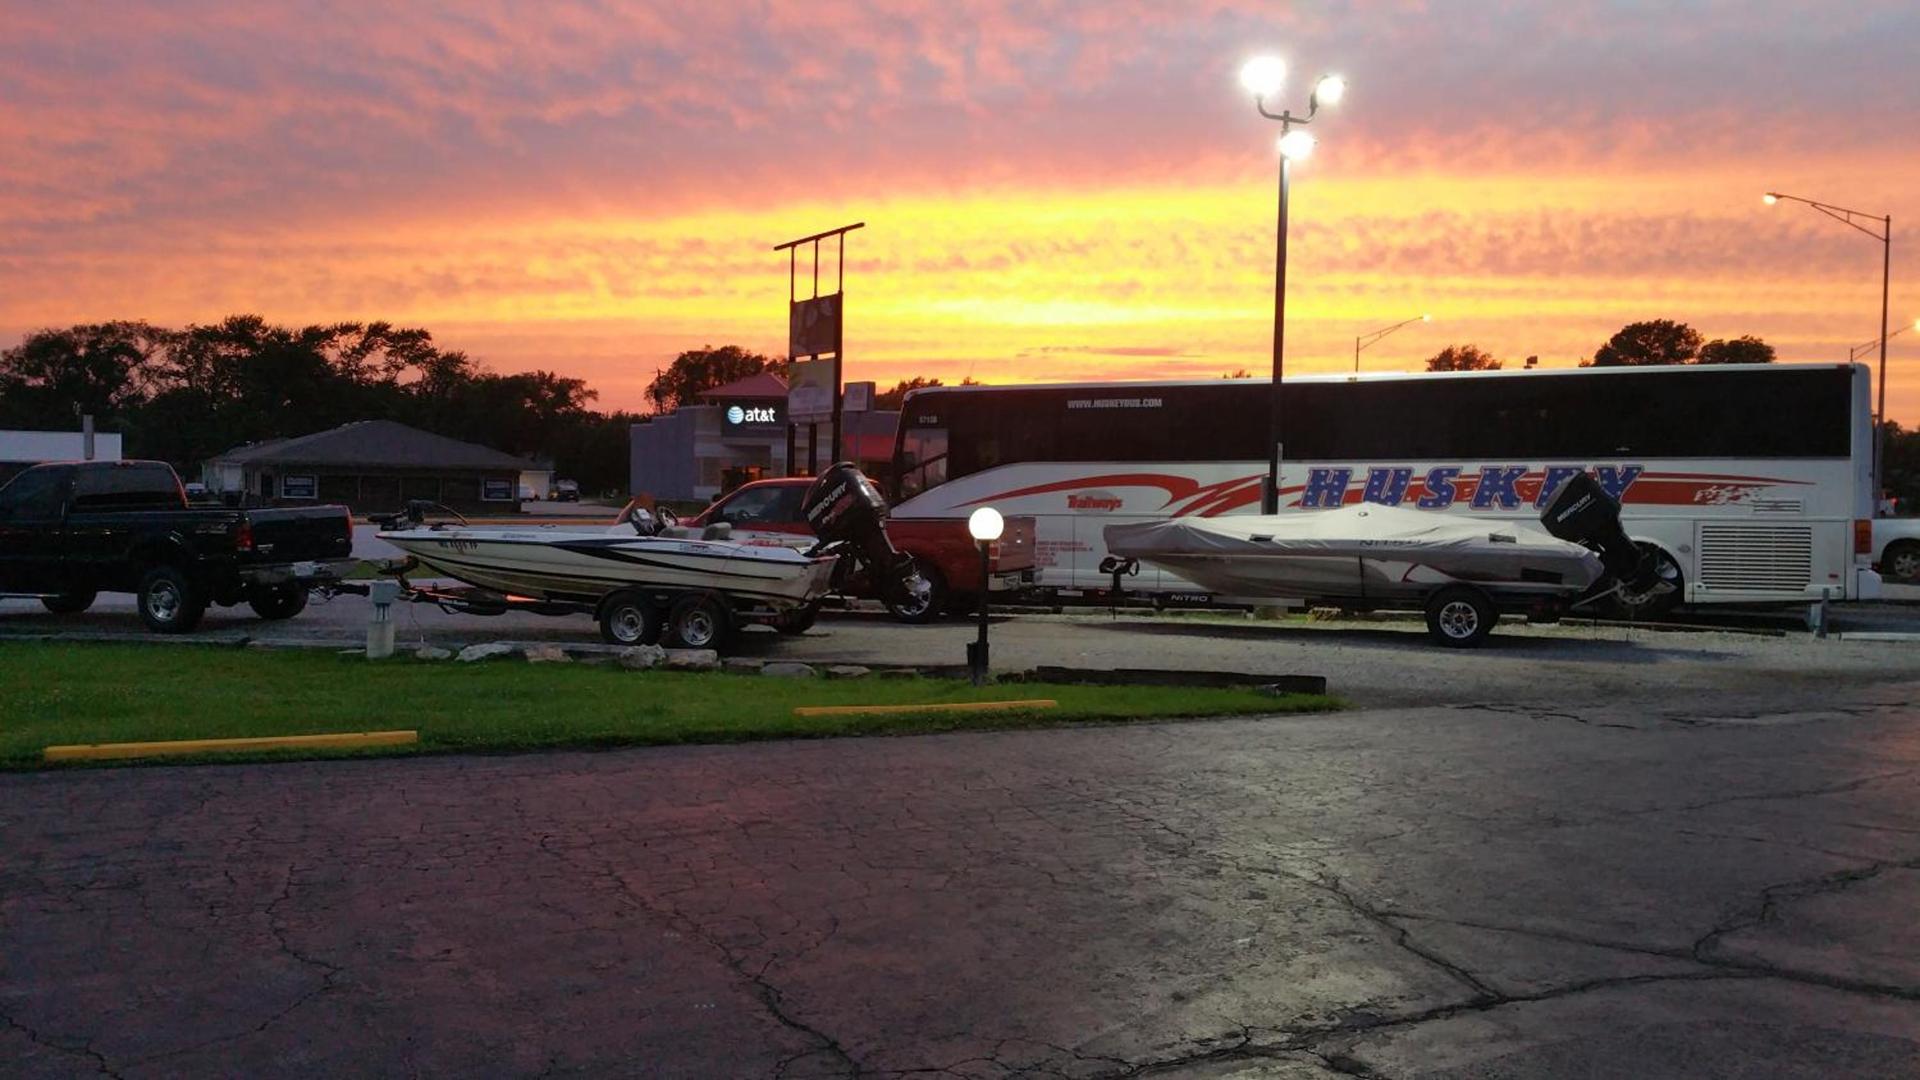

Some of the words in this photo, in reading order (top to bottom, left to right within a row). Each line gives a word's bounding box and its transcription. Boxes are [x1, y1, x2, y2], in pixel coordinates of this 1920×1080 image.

[808, 481, 847, 522] MERCURY
[1557, 492, 1591, 523] MERCURY
[1171, 594, 1208, 602] NITRO
